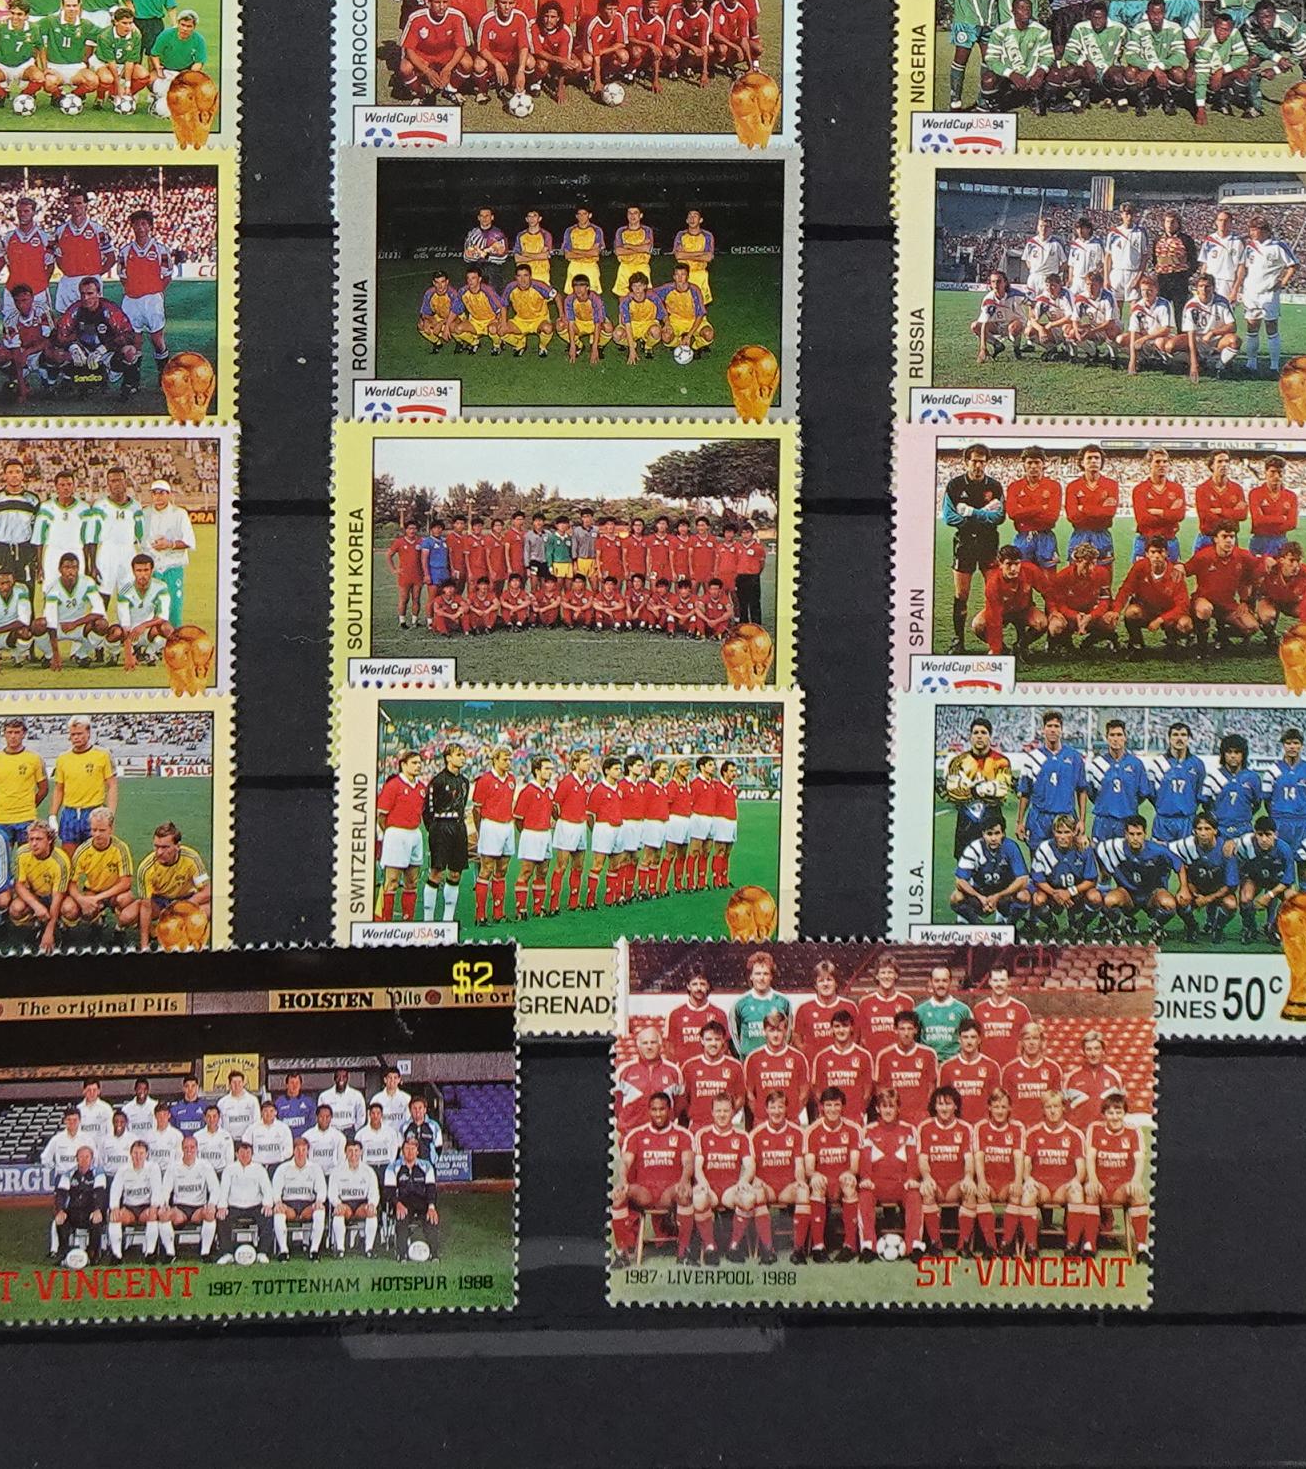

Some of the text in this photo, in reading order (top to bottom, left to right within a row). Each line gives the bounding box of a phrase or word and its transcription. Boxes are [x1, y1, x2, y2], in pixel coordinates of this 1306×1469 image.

[15, 41, 24, 52] 7
[910, 24, 927, 104] NIGERIA
[351, 279, 368, 371] ROMANIA
[908, 307, 925, 379] RUSSIA
[347, 507, 364, 650] SOUTH KOREA
[908, 589, 925, 647] SPAIN
[1050, 772, 1058, 786] 4
[1112, 779, 1122, 793] 3
[1229, 791, 1237, 805] 7
[349, 773, 368, 914] SWITZERLAND
[909, 861, 924, 916] U.S.A.
[451, 960, 494, 997] $2
[518, 970, 605, 989] INCENT
[1096, 960, 1137, 995] $2
[1170, 974, 1219, 993] AND
[18, 1001, 50, 1016] The
[57, 997, 136, 1018] original
[143, 997, 178, 1012] Pils
[278, 991, 374, 1009] HOLSTEN
[208, 1274, 494, 1296] 1987 TOTTENHAM HOTSPUR 1988
[625, 1270, 797, 1286] 1987 LIVERPOOL 1988
